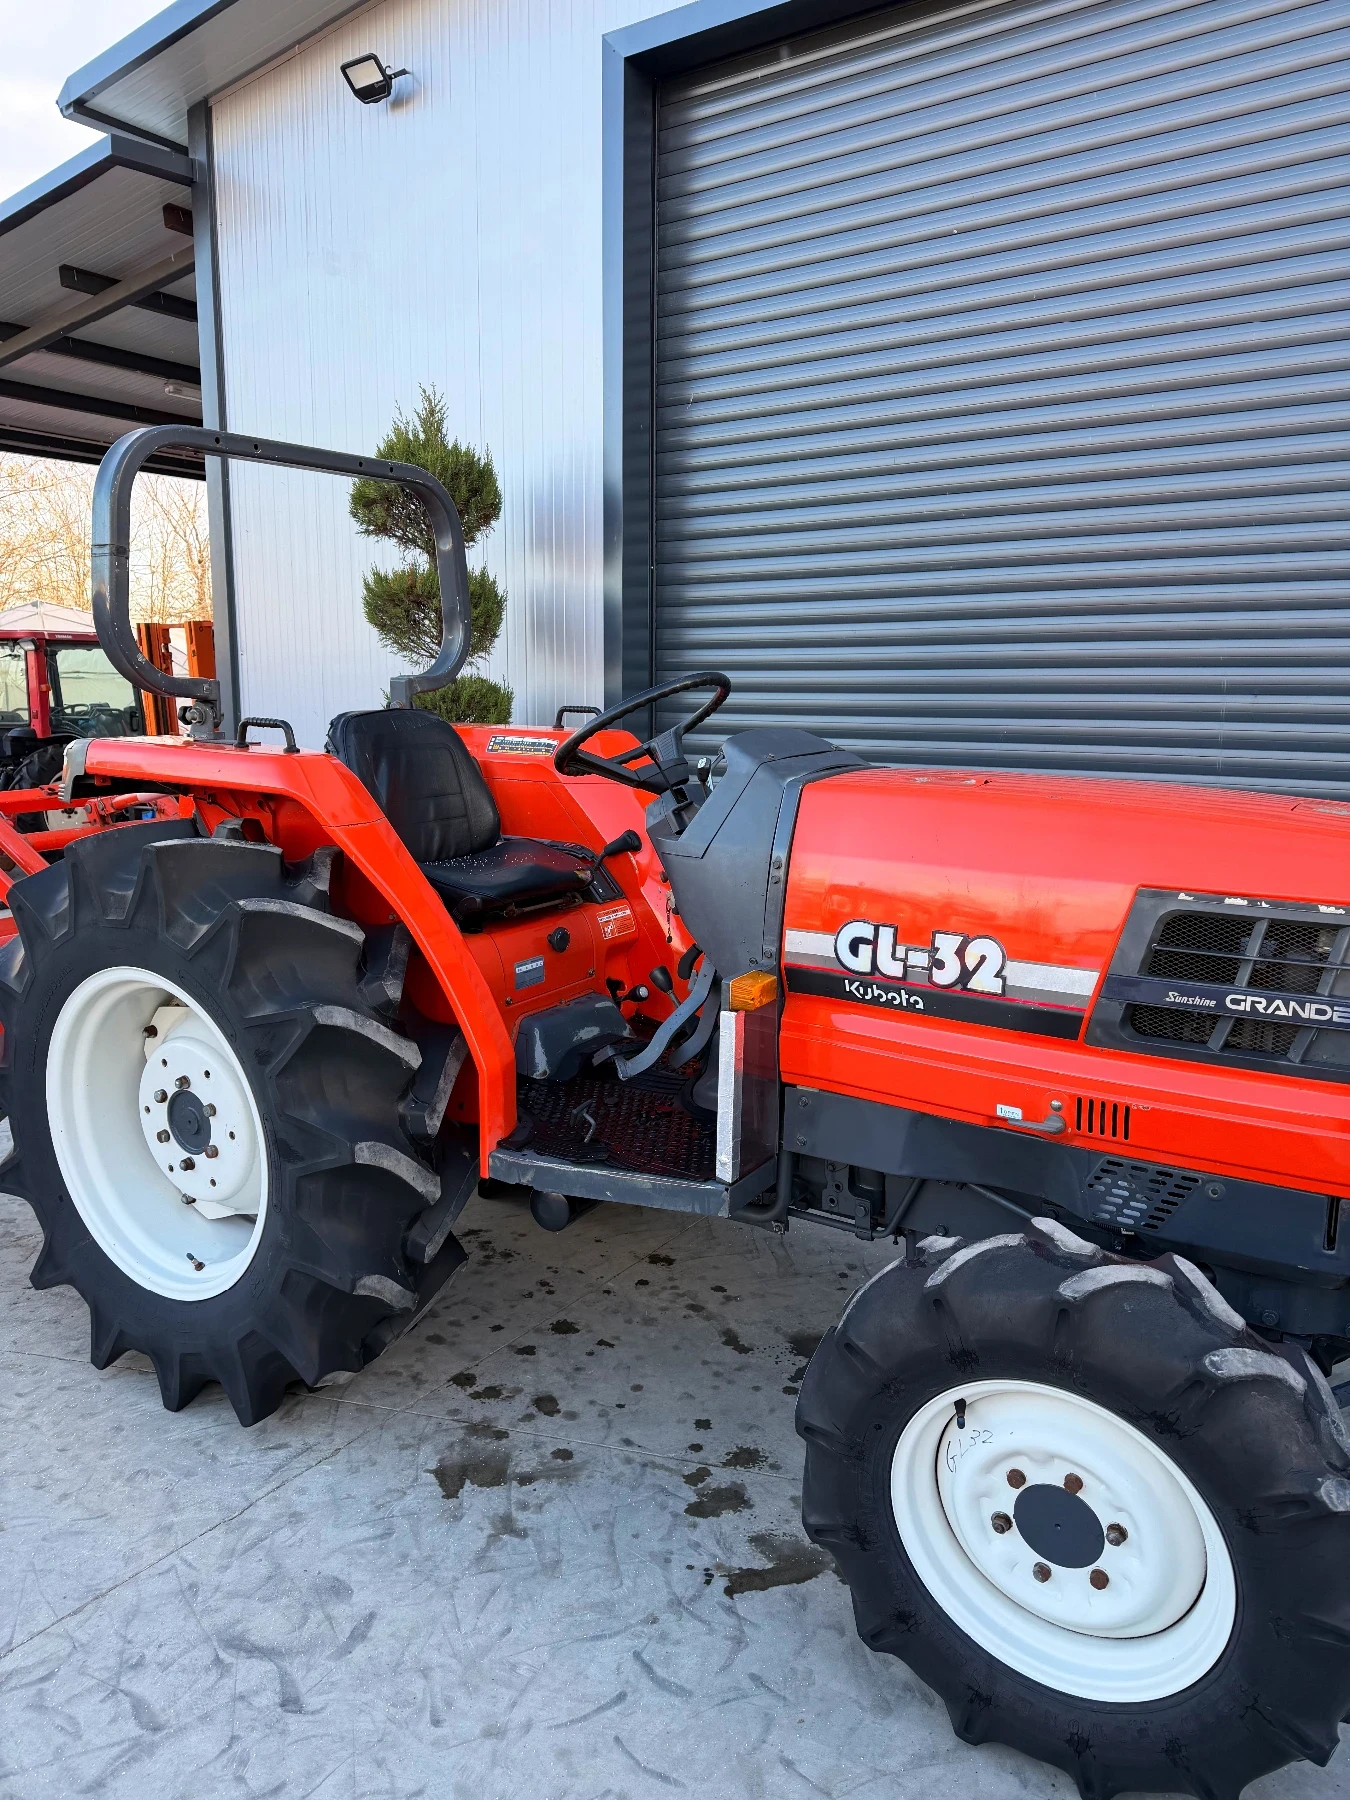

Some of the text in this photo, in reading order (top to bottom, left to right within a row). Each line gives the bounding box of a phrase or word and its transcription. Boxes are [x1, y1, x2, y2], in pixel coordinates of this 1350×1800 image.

[834, 919, 1007, 996] GL-32
[844, 979, 925, 1010] Kubota
[1163, 991, 1217, 1008] Sunshine
